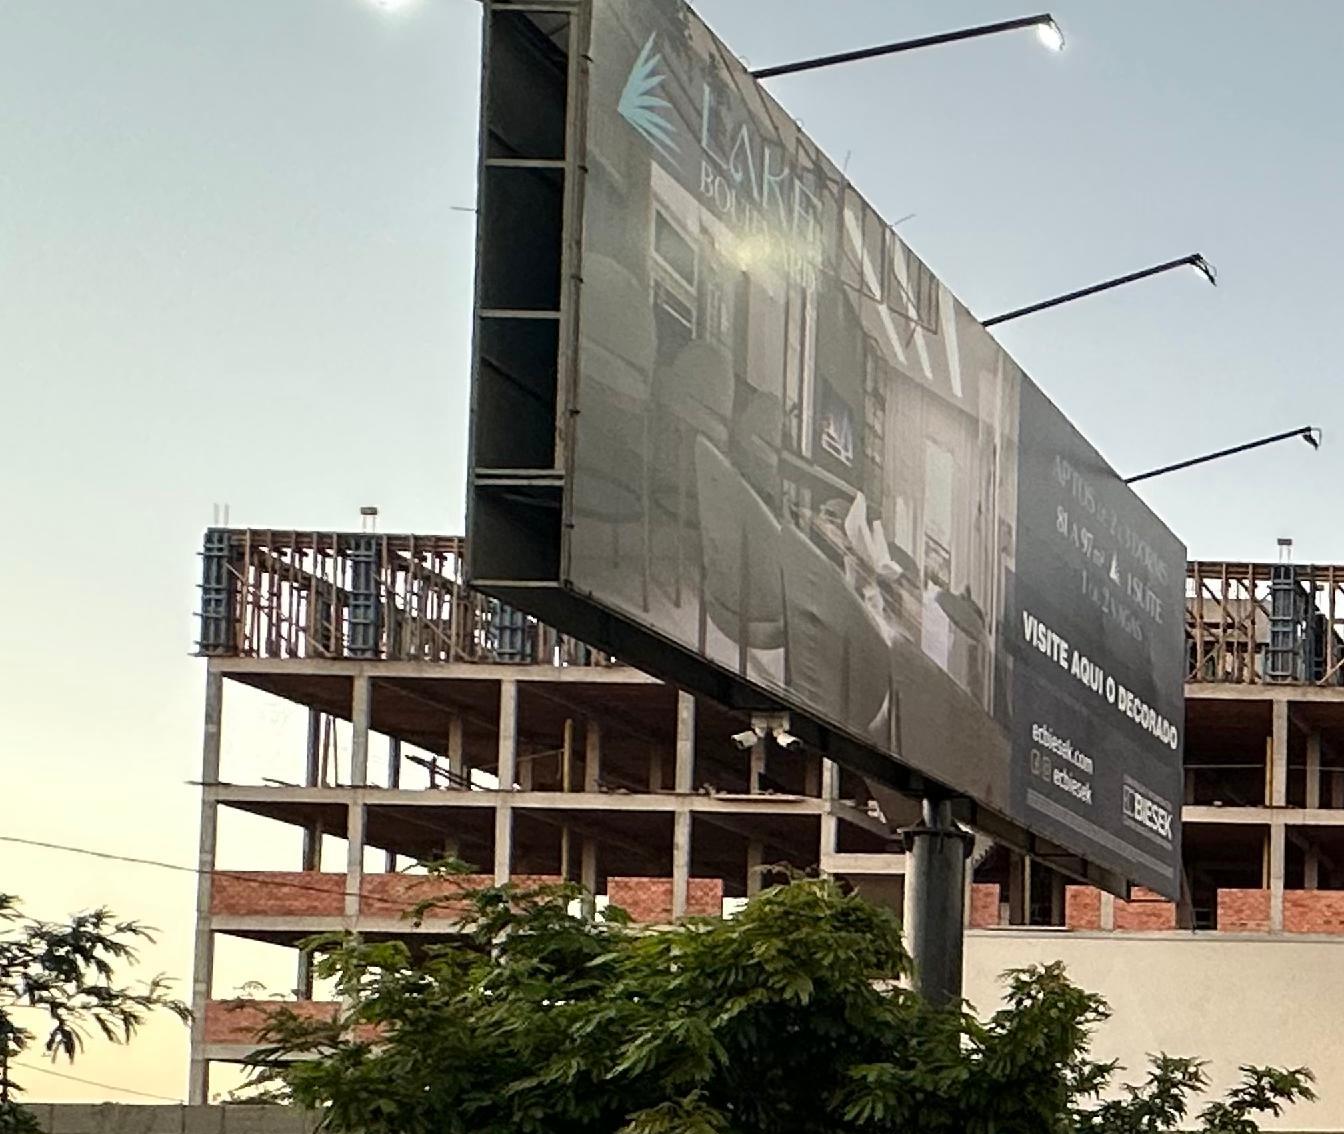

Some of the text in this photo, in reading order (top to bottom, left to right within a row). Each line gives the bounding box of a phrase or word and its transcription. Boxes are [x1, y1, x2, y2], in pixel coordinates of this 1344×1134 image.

[702, 83, 823, 258] LAKE
[1022, 610, 1178, 750] VISITE AQUI O DECORADO
